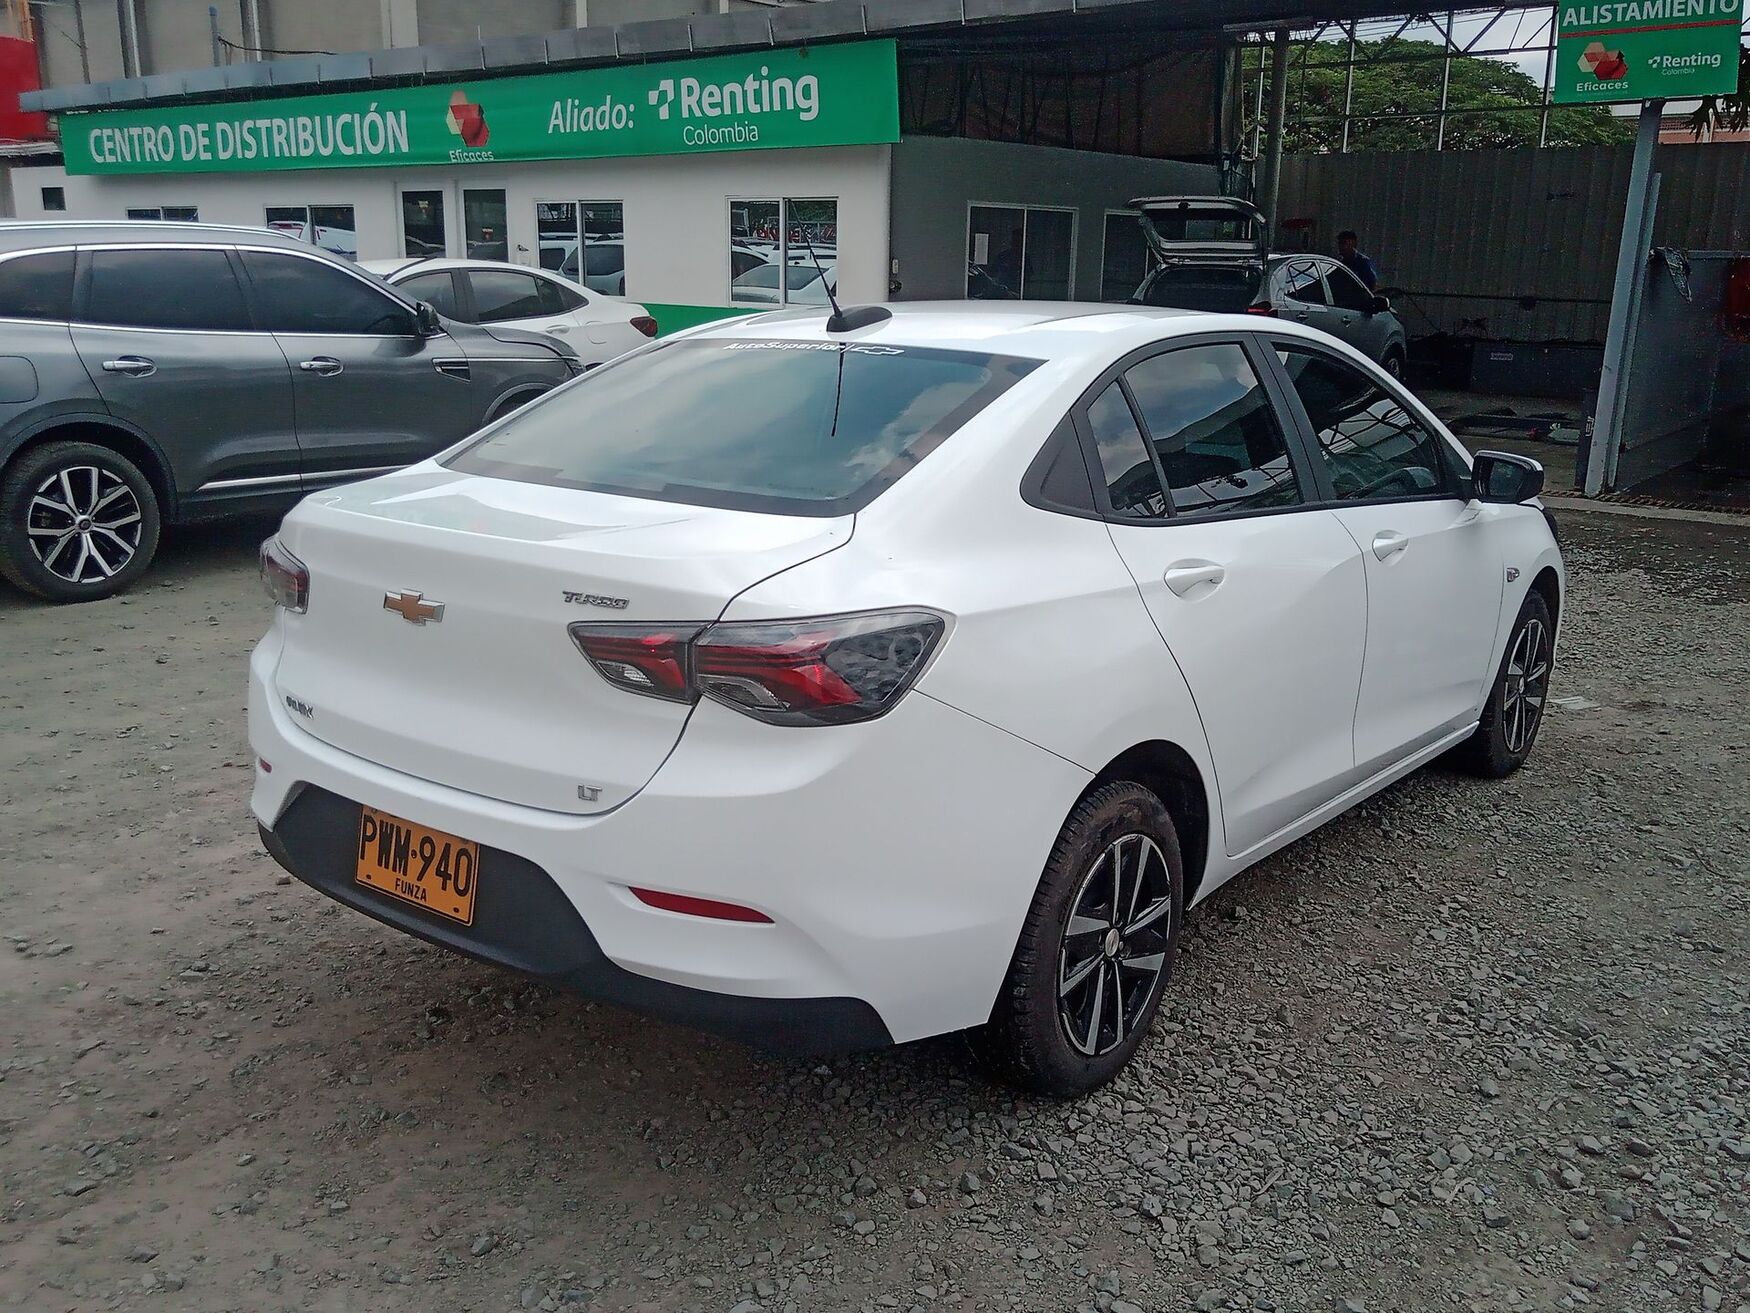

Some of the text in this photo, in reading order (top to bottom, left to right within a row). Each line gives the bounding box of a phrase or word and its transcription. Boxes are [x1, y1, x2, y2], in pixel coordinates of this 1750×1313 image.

[1662, 52, 1722, 68] Renting
[1576, 81, 1629, 92] Eficaces
[548, 66, 820, 134] Aliado: Renting
[89, 102, 410, 163] CENTRO DE DISTRIBUCIÓN
[682, 122, 759, 146] Colombia
[449, 149, 494, 163] Eficaces
[577, 784, 603, 802] LT
[394, 878, 427, 903] FUNZA
